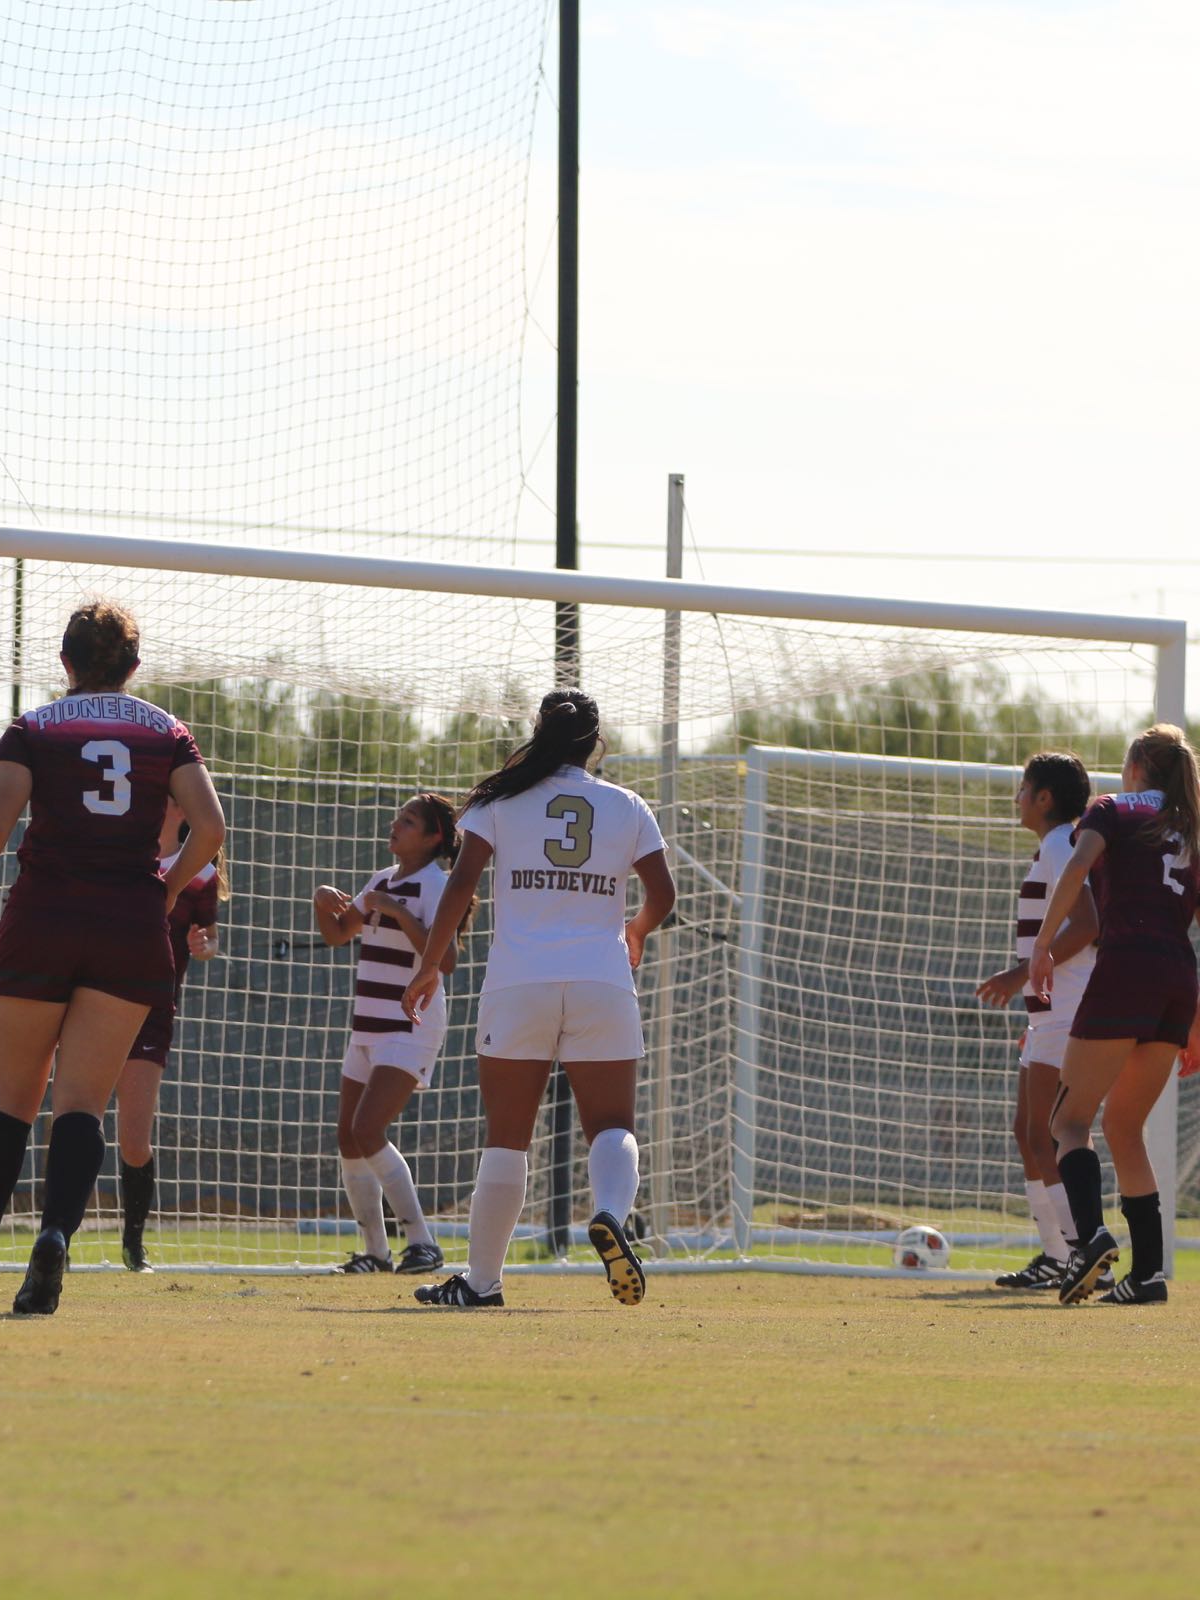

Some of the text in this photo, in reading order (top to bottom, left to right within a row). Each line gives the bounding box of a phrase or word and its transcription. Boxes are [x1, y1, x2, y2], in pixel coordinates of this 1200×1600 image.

[36, 696, 169, 735] PIONEERS
[81, 740, 132, 816] 3
[543, 794, 594, 868] 3
[511, 870, 617, 896] DUSTDEVILS
